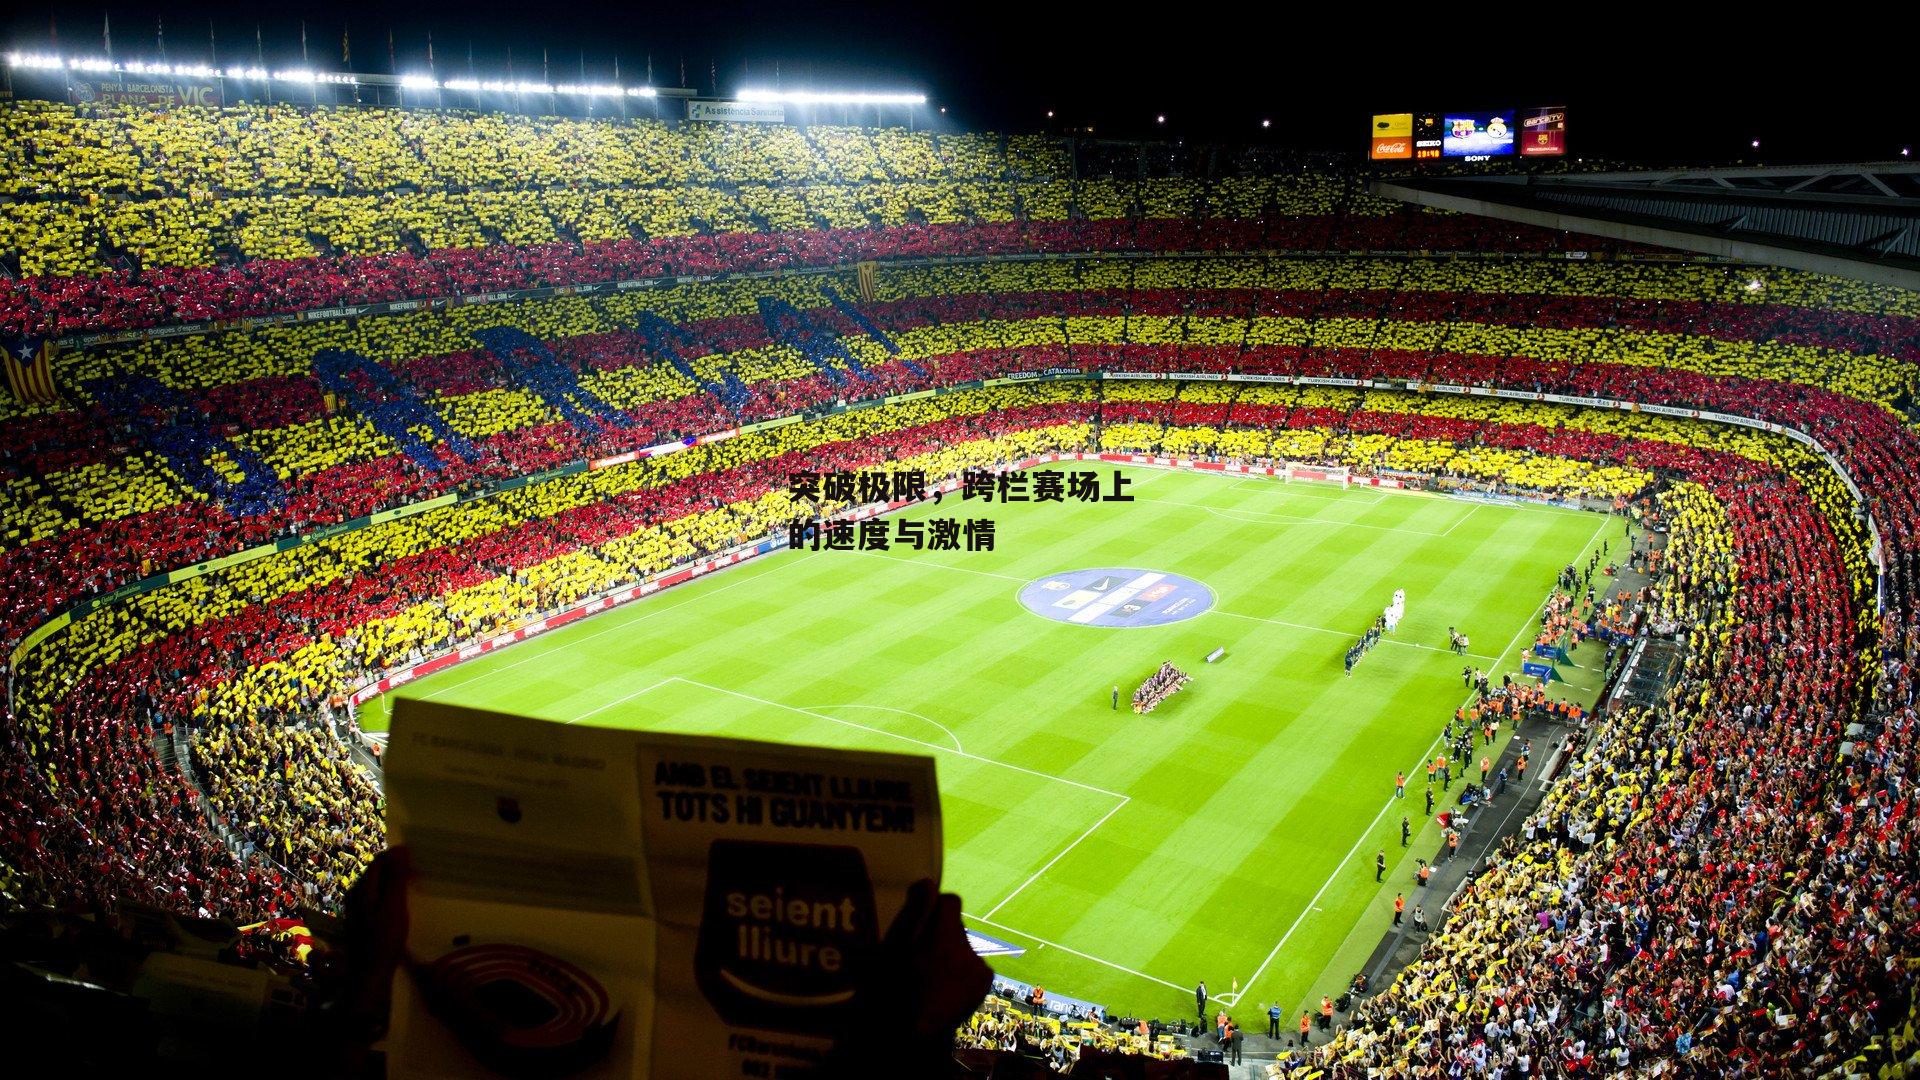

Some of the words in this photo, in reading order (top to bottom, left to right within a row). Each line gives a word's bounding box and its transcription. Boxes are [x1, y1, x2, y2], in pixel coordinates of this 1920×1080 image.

[101, 83, 124, 92] PENYA
[101, 93, 148, 105] PLANA
[158, 95, 175, 106] DE
[177, 84, 214, 106] VIC
[308, 307, 357, 319] NIKEFOOTBALL.COM
[149, 327, 175, 335] Botigues
[1007, 371, 1038, 380] FREEDOM
[1043, 367, 1080, 376] CATALONIA
[1508, 391, 1534, 399] AIRLINES
[1558, 396, 1584, 404] TURKISH
[1638, 403, 1662, 412] URKISH
[1661, 407, 1689, 416] AIRLINES
[1714, 414, 1739, 424] TURKISH
[1739, 418, 1763, 428] AIRLINES
[655, 761, 706, 787] AMB
[711, 765, 739, 790] EL
[743, 767, 825, 799] SEIENT
[830, 775, 911, 801] LLIURE
[657, 791, 730, 824] TOTS
[736, 795, 763, 826] HI
[769, 798, 916, 833] GUANYEM!
[727, 886, 856, 931] seient
[738, 924, 842, 972] lliure
